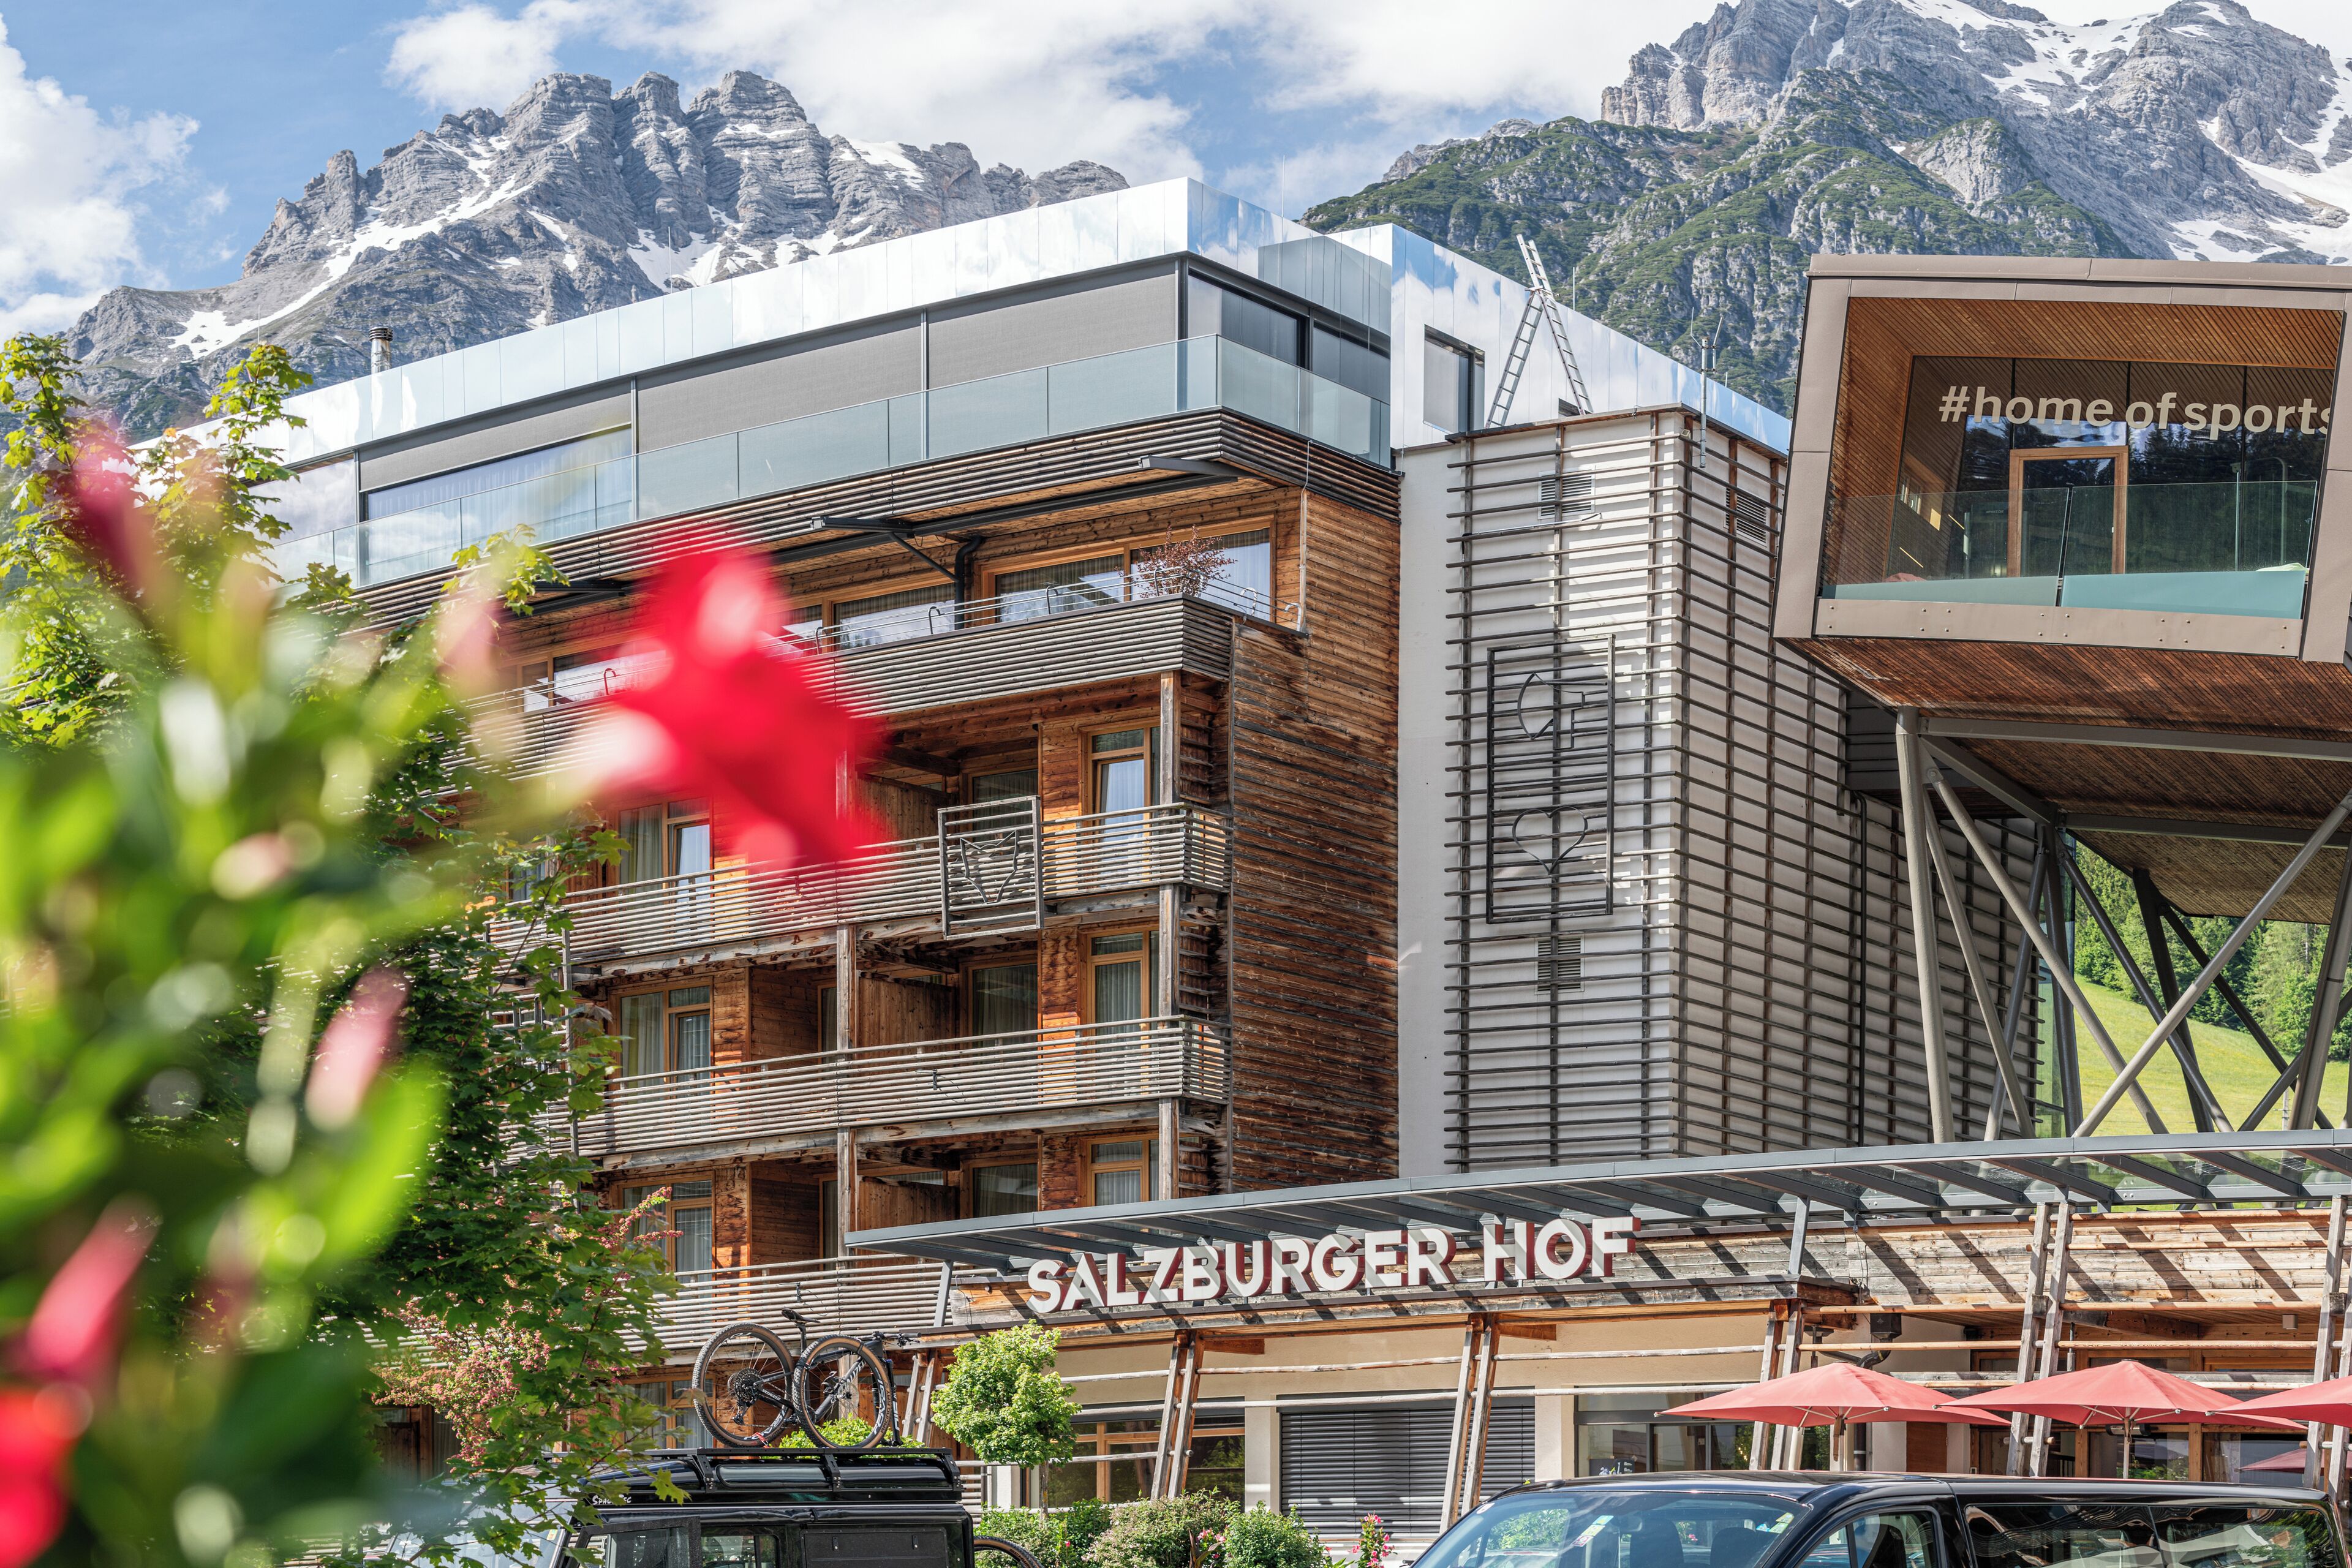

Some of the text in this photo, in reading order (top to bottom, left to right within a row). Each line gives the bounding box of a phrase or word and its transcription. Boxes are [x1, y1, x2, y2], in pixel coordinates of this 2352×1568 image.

[1939, 386, 2114, 427] #home
[2125, 392, 2177, 430] of
[1026, 1216, 1641, 1313] SALZBURGER HOF
